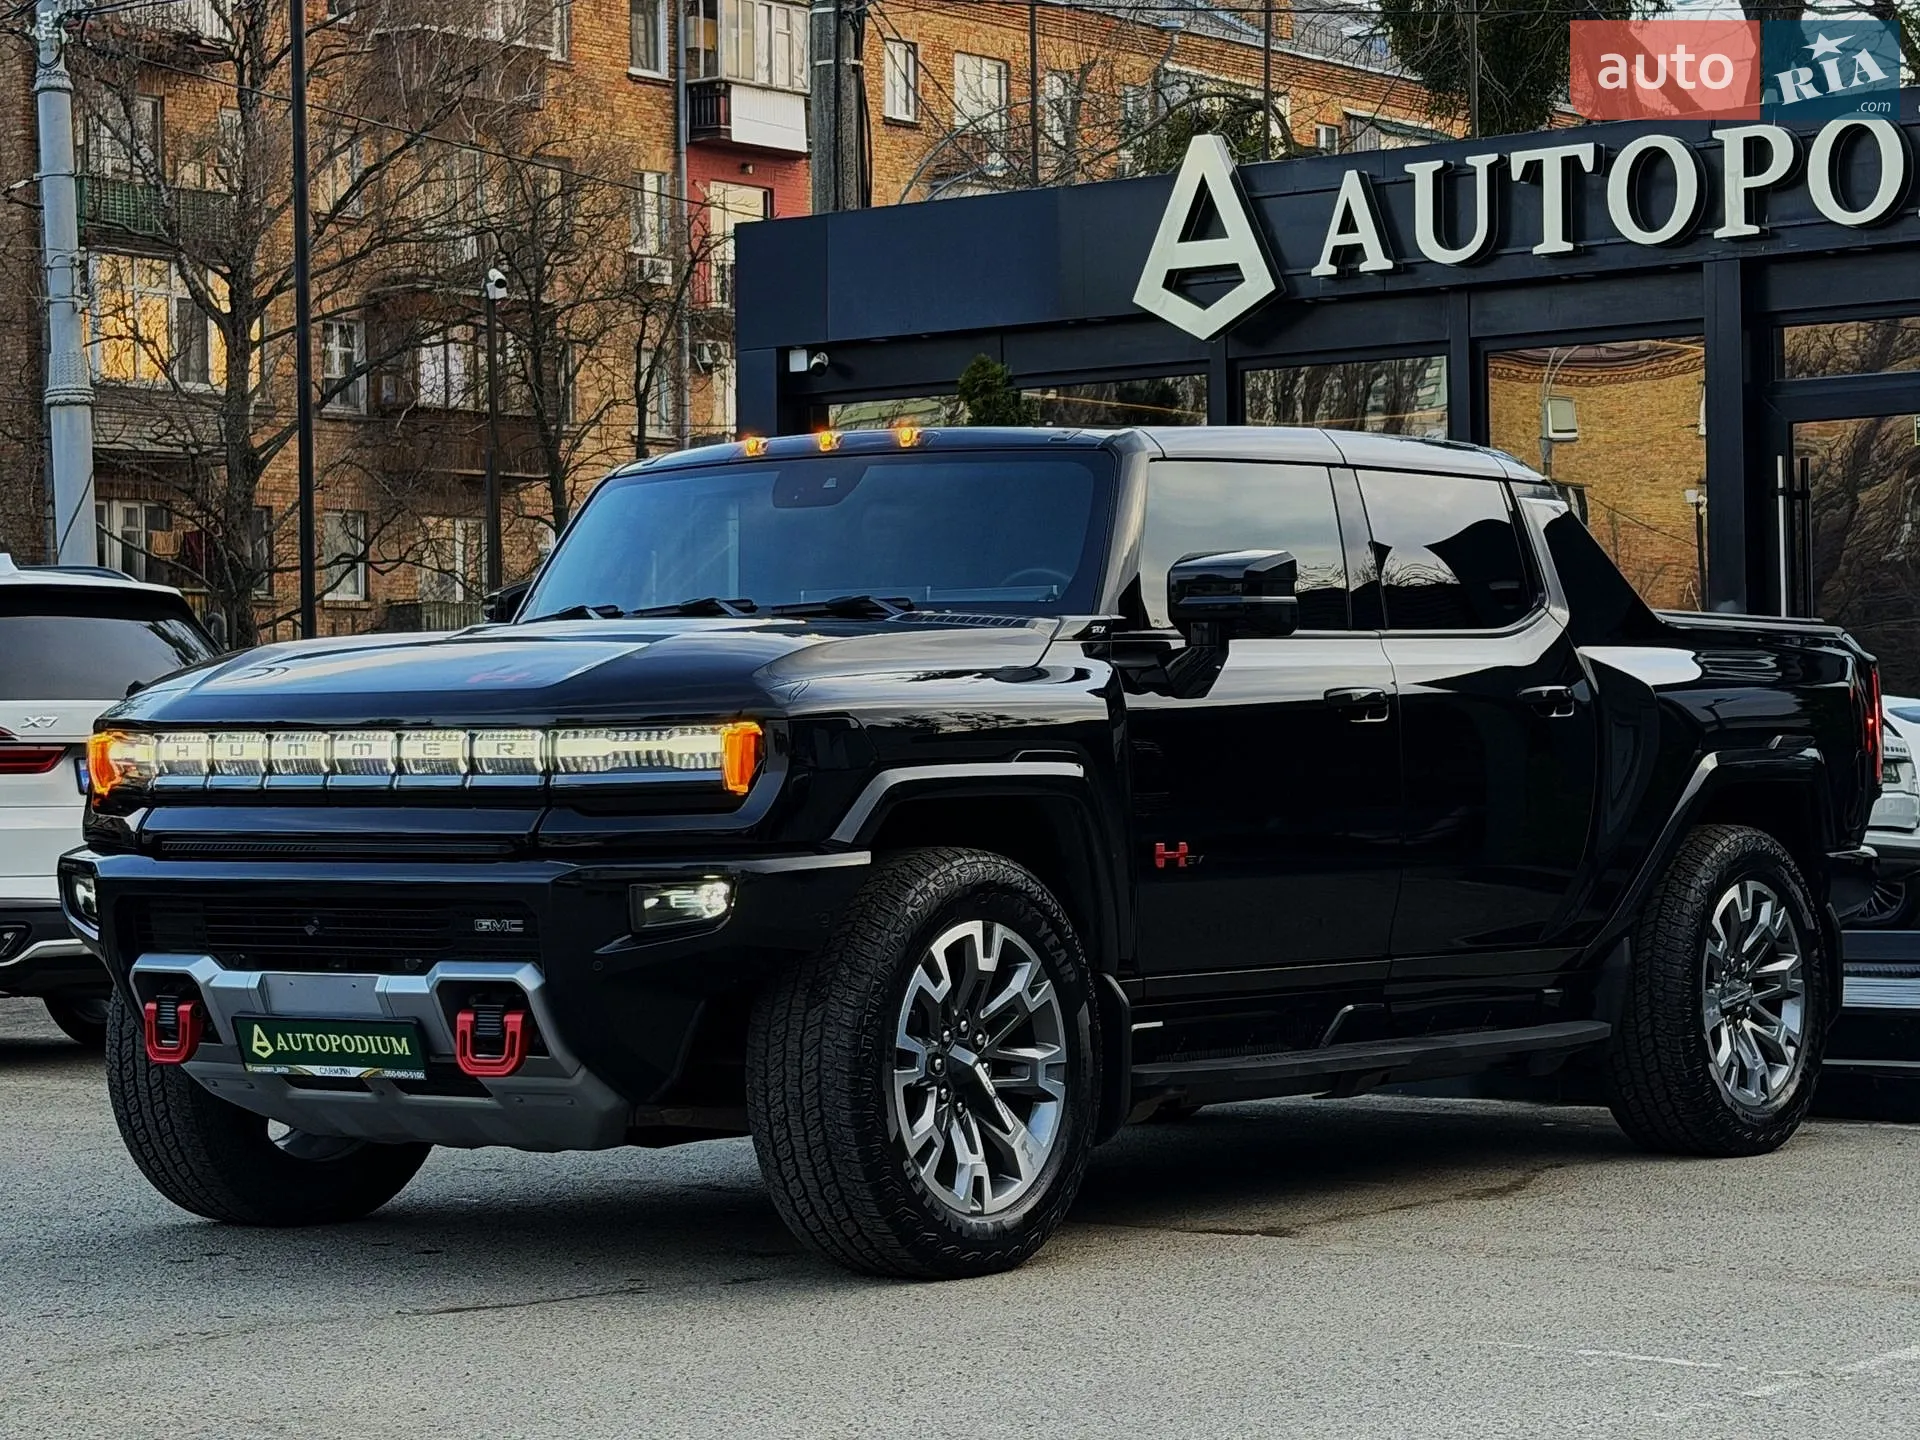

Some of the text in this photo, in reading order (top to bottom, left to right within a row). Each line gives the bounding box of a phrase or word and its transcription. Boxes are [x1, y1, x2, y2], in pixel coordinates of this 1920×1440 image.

[1311, 116, 1920, 277] AUTOPO
[20, 715, 58, 728] X7
[176, 742, 515, 758] HUMMER
[474, 918, 524, 932] GMC
[276, 1032, 412, 1056] AUTOPODIUM
